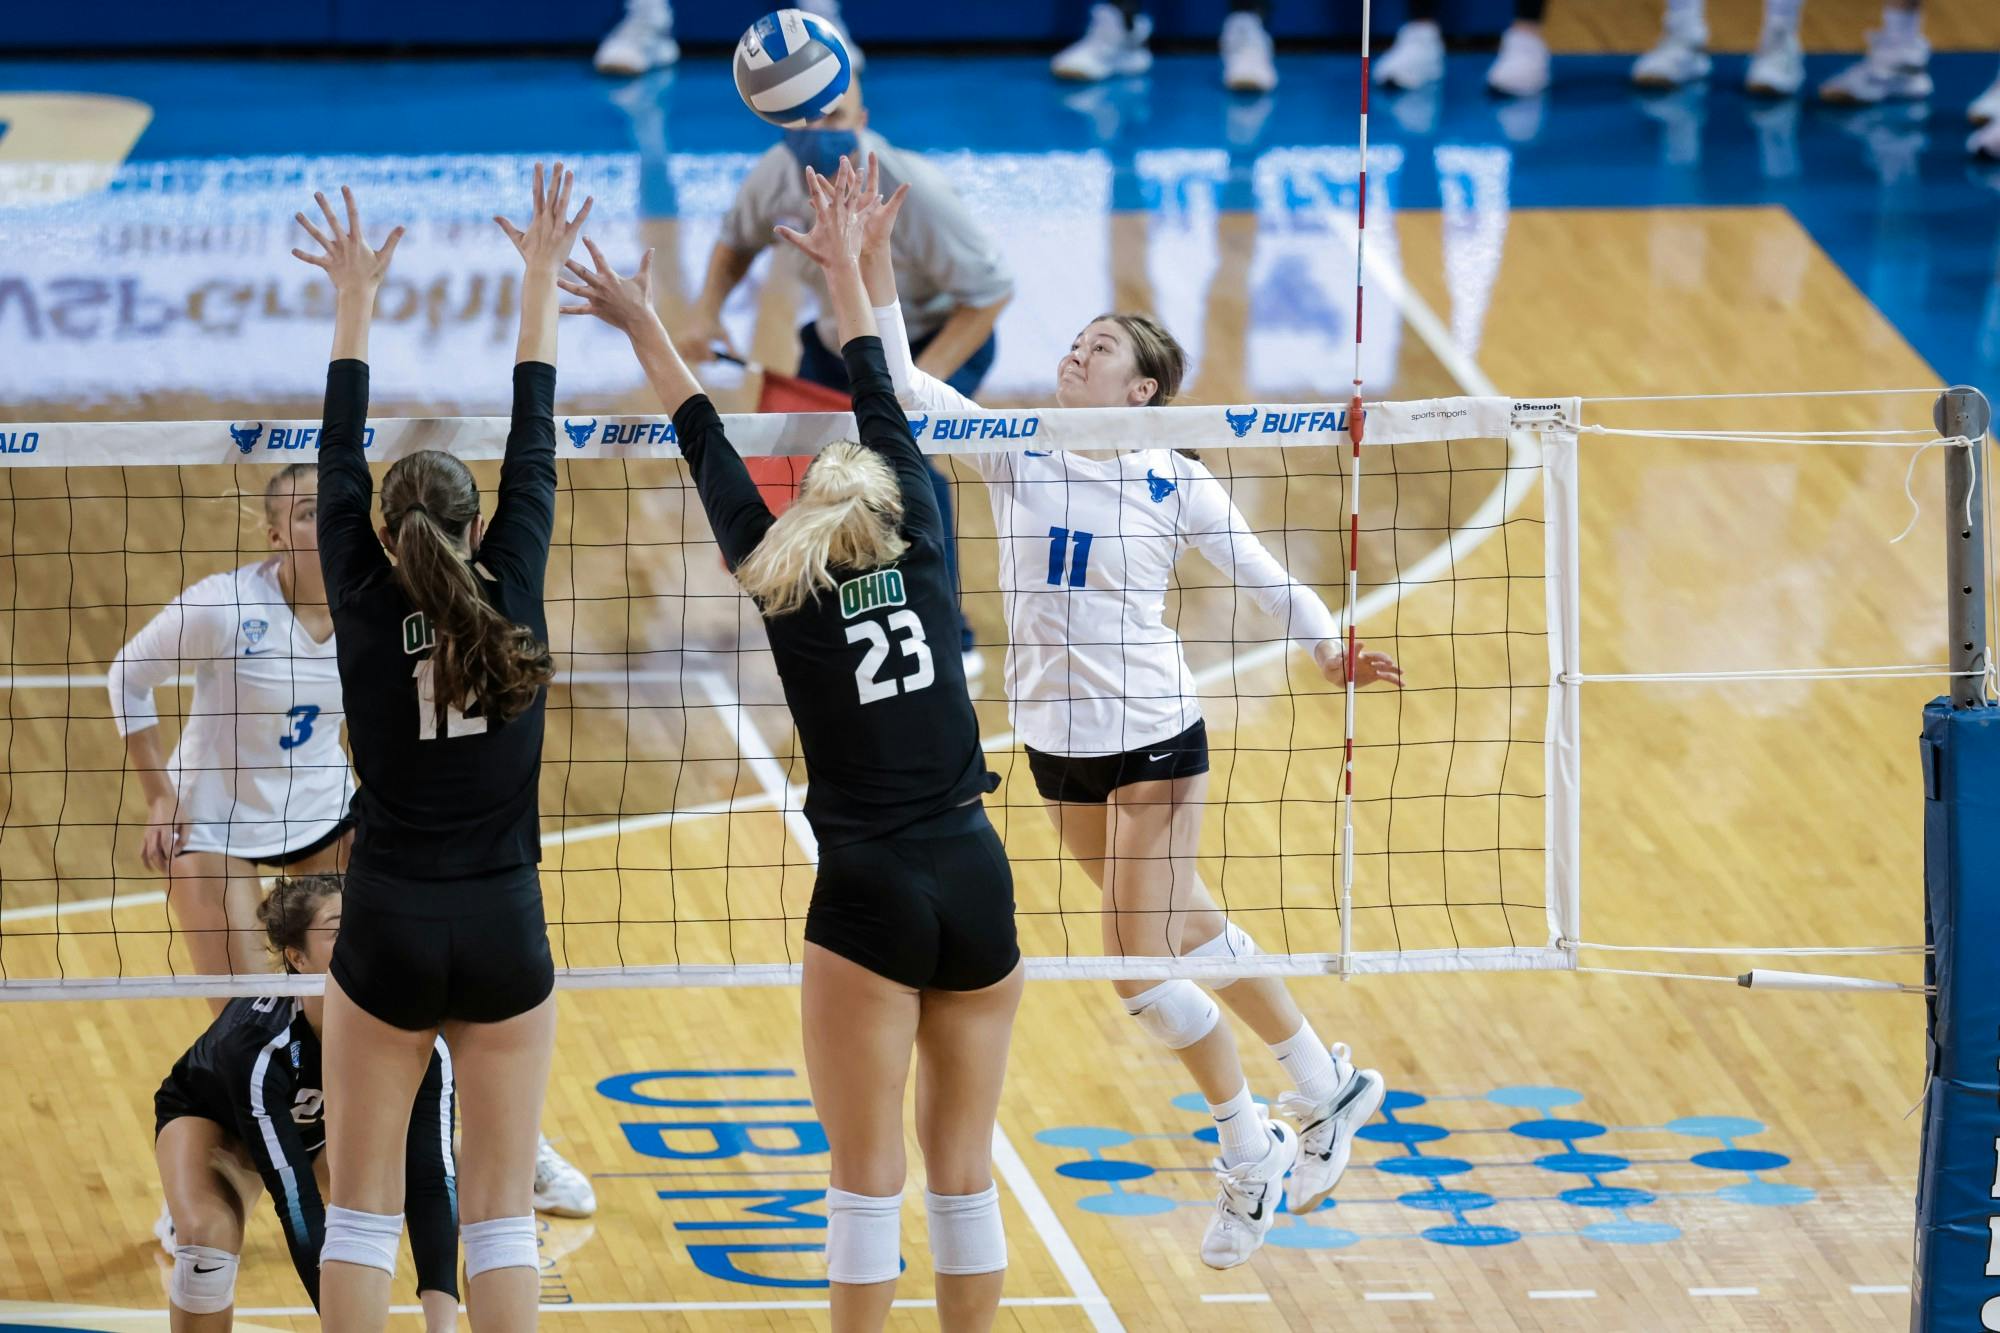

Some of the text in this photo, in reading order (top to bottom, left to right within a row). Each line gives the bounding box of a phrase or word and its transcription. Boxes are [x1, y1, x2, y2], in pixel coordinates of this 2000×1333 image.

[932, 417, 1039, 440] BUFFALO
[1262, 410, 1367, 433] BUFFAL
[1411, 409, 1467, 420] sports imports
[1047, 526, 1093, 587] 11
[839, 569, 907, 619] OHIO
[844, 609, 935, 705] 23
[279, 705, 320, 750] 3
